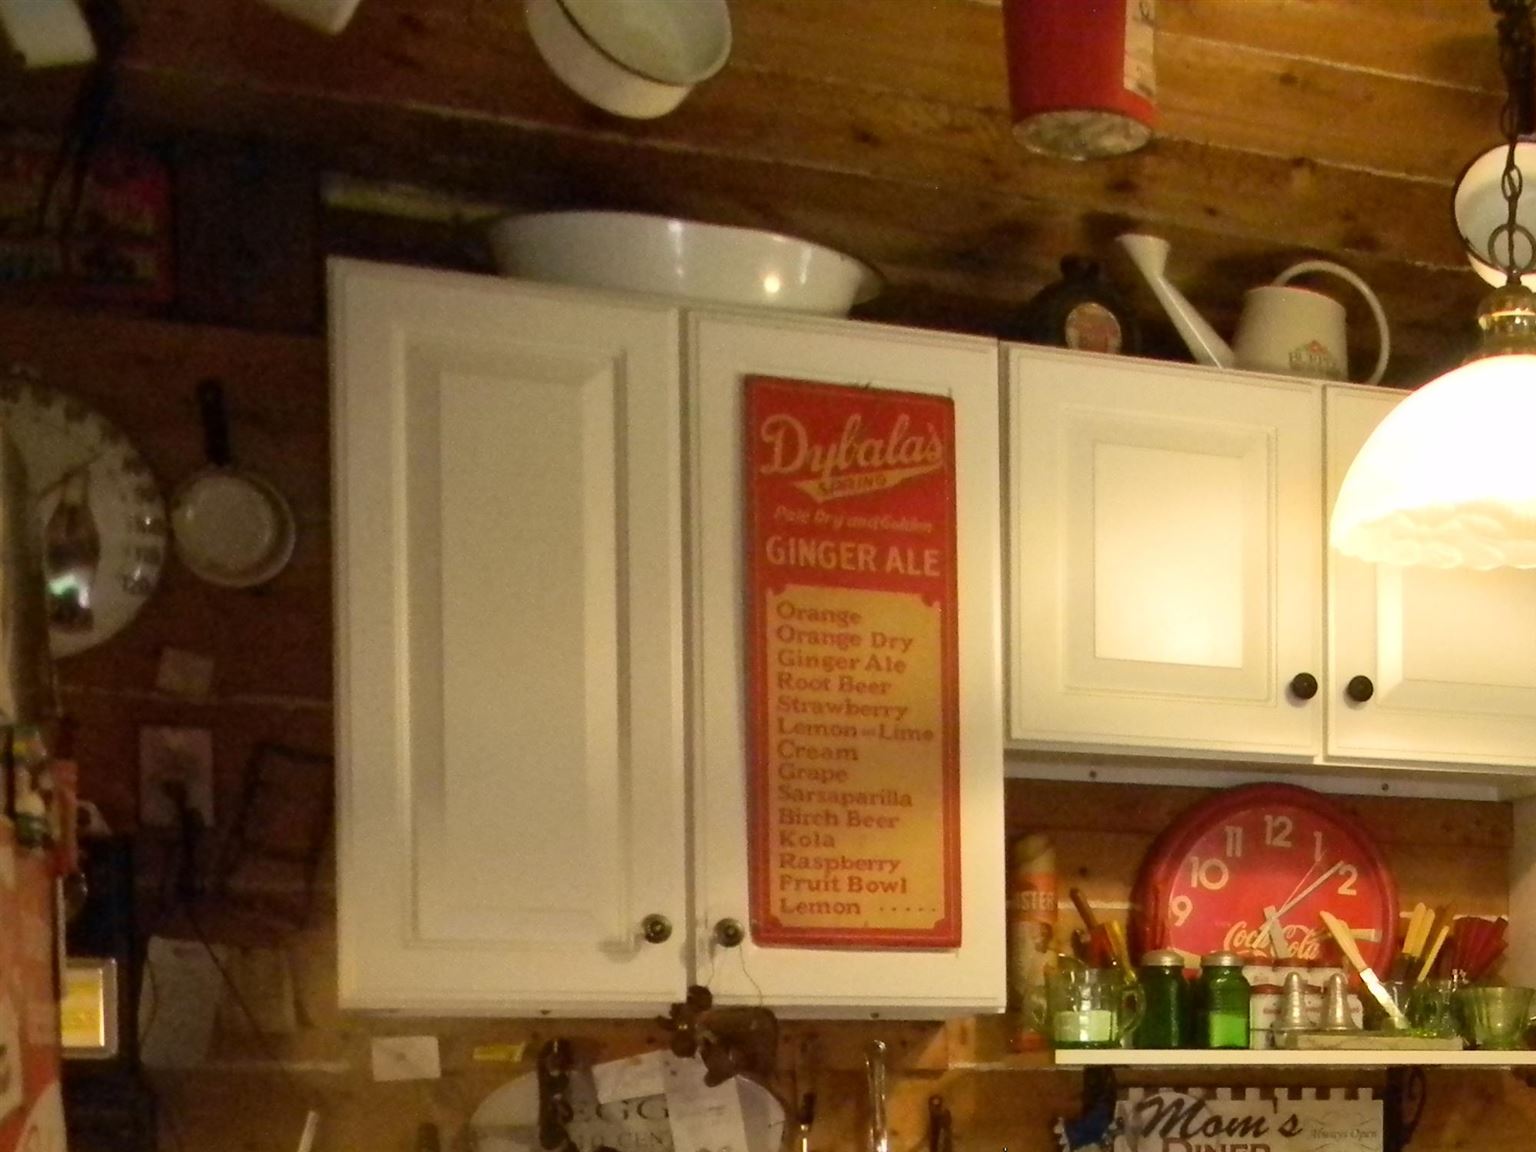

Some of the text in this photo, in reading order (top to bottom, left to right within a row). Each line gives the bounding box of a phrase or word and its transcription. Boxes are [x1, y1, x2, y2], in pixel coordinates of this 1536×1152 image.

[765, 536, 941, 577] GINGER ALE
[776, 601, 862, 628] Orange
[776, 624, 913, 653] Orange Dry
[777, 649, 906, 674] Ginger Ale
[777, 671, 891, 694] Root Beer
[777, 695, 908, 720] Strawberry
[777, 738, 858, 761] Cream
[778, 762, 848, 784] Grape
[778, 783, 912, 807] Sarsaparilla
[779, 807, 900, 829] Birch Beer
[1264, 815, 1294, 848] 12
[779, 829, 835, 848] Kola
[1225, 826, 1244, 858] 11
[1313, 831, 1324, 862] 1
[779, 852, 902, 879] Raspberry
[1191, 856, 1230, 891] 10
[779, 873, 907, 895] Fruit Bowl
[1337, 864, 1359, 896] 2
[779, 897, 861, 915] Lemon
[1171, 895, 1194, 927] 9
[1132, 1095, 1303, 1139] Mom's
